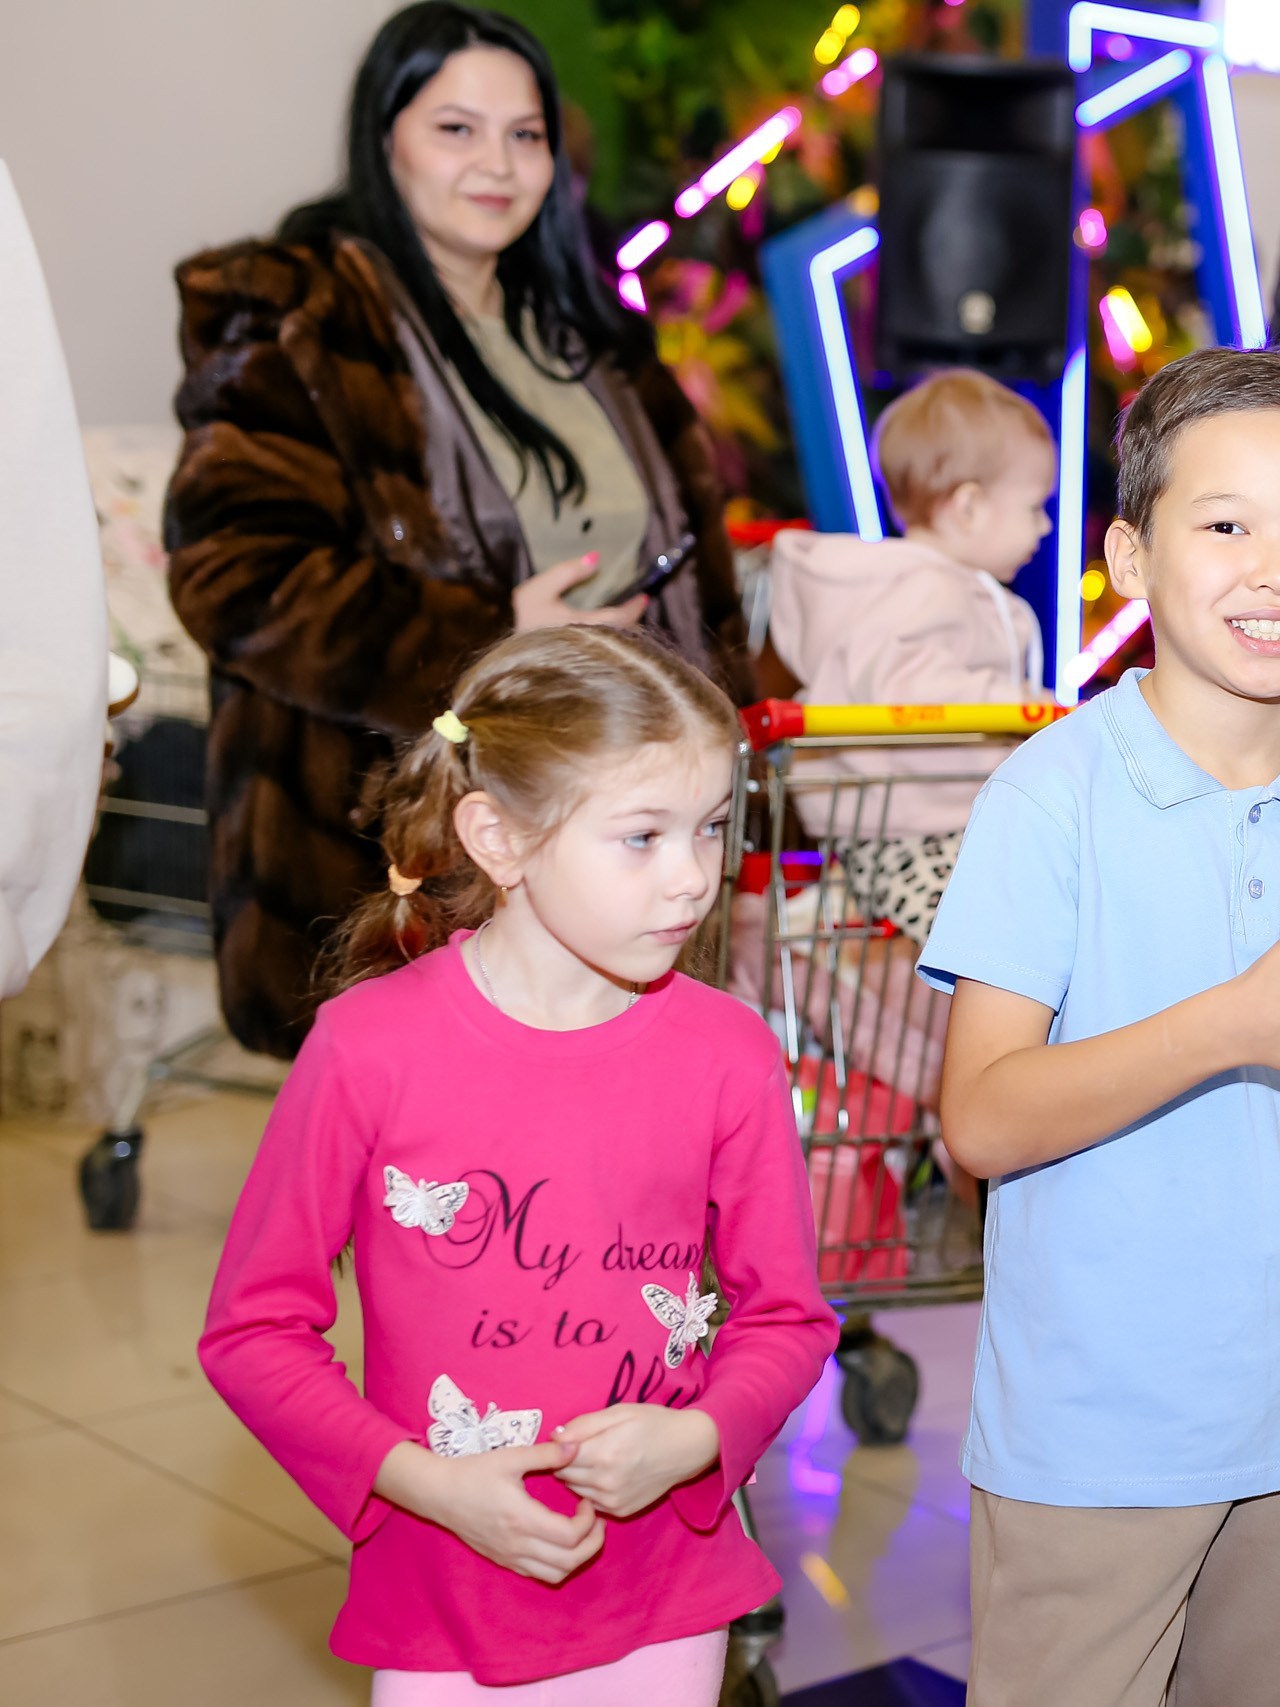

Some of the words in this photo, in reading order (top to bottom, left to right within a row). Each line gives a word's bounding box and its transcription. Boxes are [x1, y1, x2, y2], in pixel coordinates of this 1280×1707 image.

[423, 1169, 582, 1291] My
[471, 1310, 533, 1348] is
[553, 1310, 619, 1348] to
